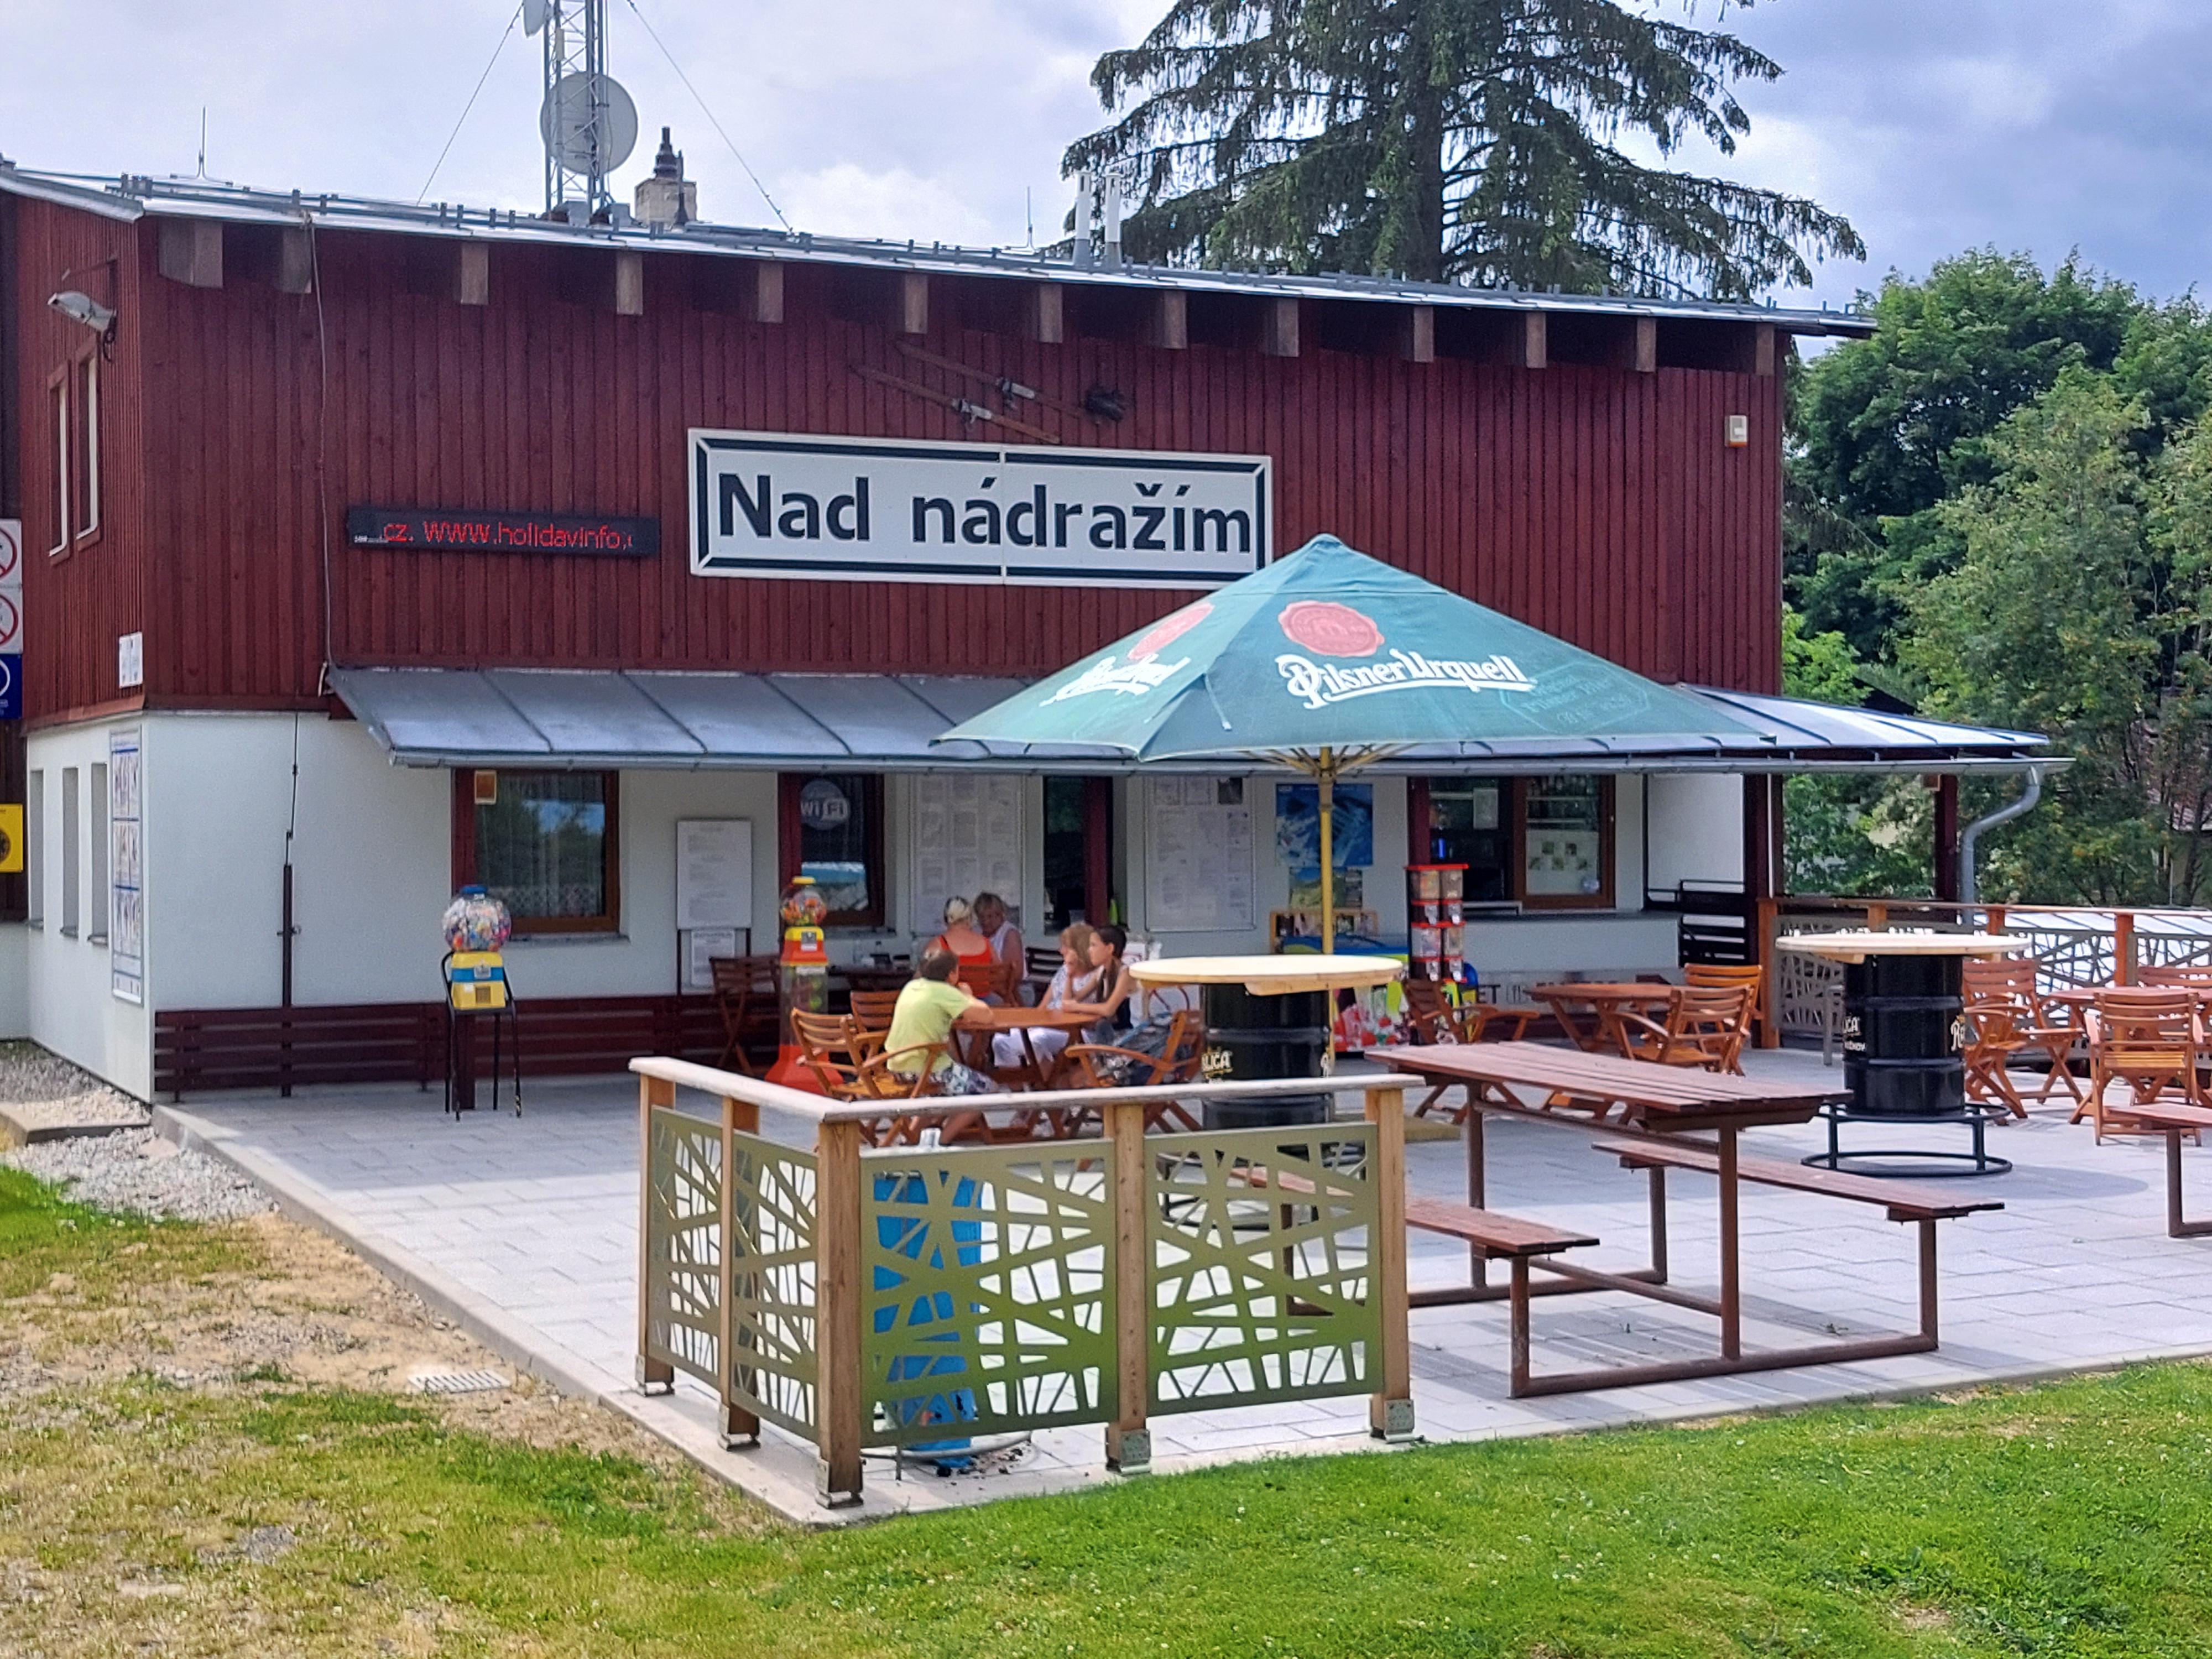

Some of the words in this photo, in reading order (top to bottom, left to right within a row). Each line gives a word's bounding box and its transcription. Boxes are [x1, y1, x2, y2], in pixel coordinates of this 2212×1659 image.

[719, 473, 869, 541] Nad
[914, 478, 1251, 554] nádražím
[1274, 654, 1405, 709] Pilsner
[1389, 648, 1531, 692] Urquell
